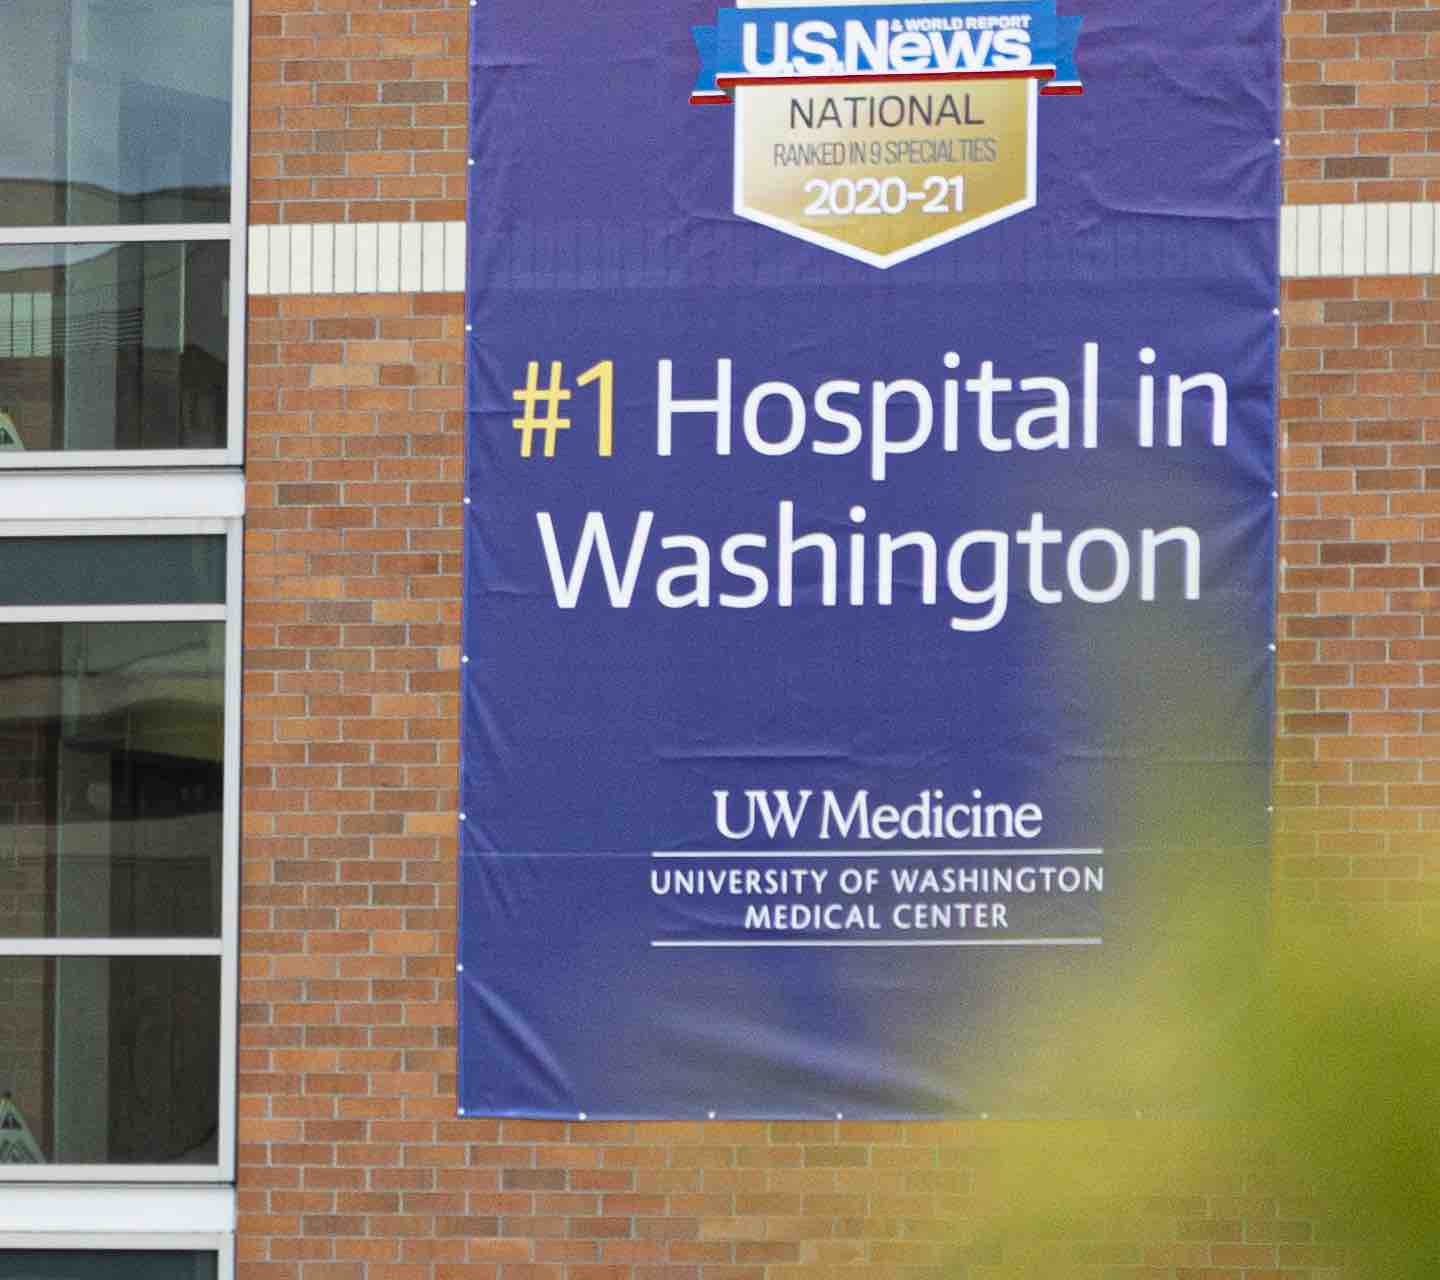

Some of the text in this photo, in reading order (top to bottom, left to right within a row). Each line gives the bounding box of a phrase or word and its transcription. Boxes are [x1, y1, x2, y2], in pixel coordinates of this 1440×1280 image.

[905, 16, 963, 31] WORLD
[966, 14, 1032, 29] REPORT
[789, 93, 985, 129] NATIONAL
[774, 138, 997, 167] RANKED IN 9 SPECIALTIES
[804, 175, 964, 217] 2020-21
[512, 342, 1229, 481] #1 Hospital in
[536, 500, 1203, 632] Washington
[713, 789, 1043, 839] UW Medicine
[650, 866, 1105, 896] UNIVERSITY OF WASHINGTON
[744, 902, 1009, 930] MEDICAL CENTER
